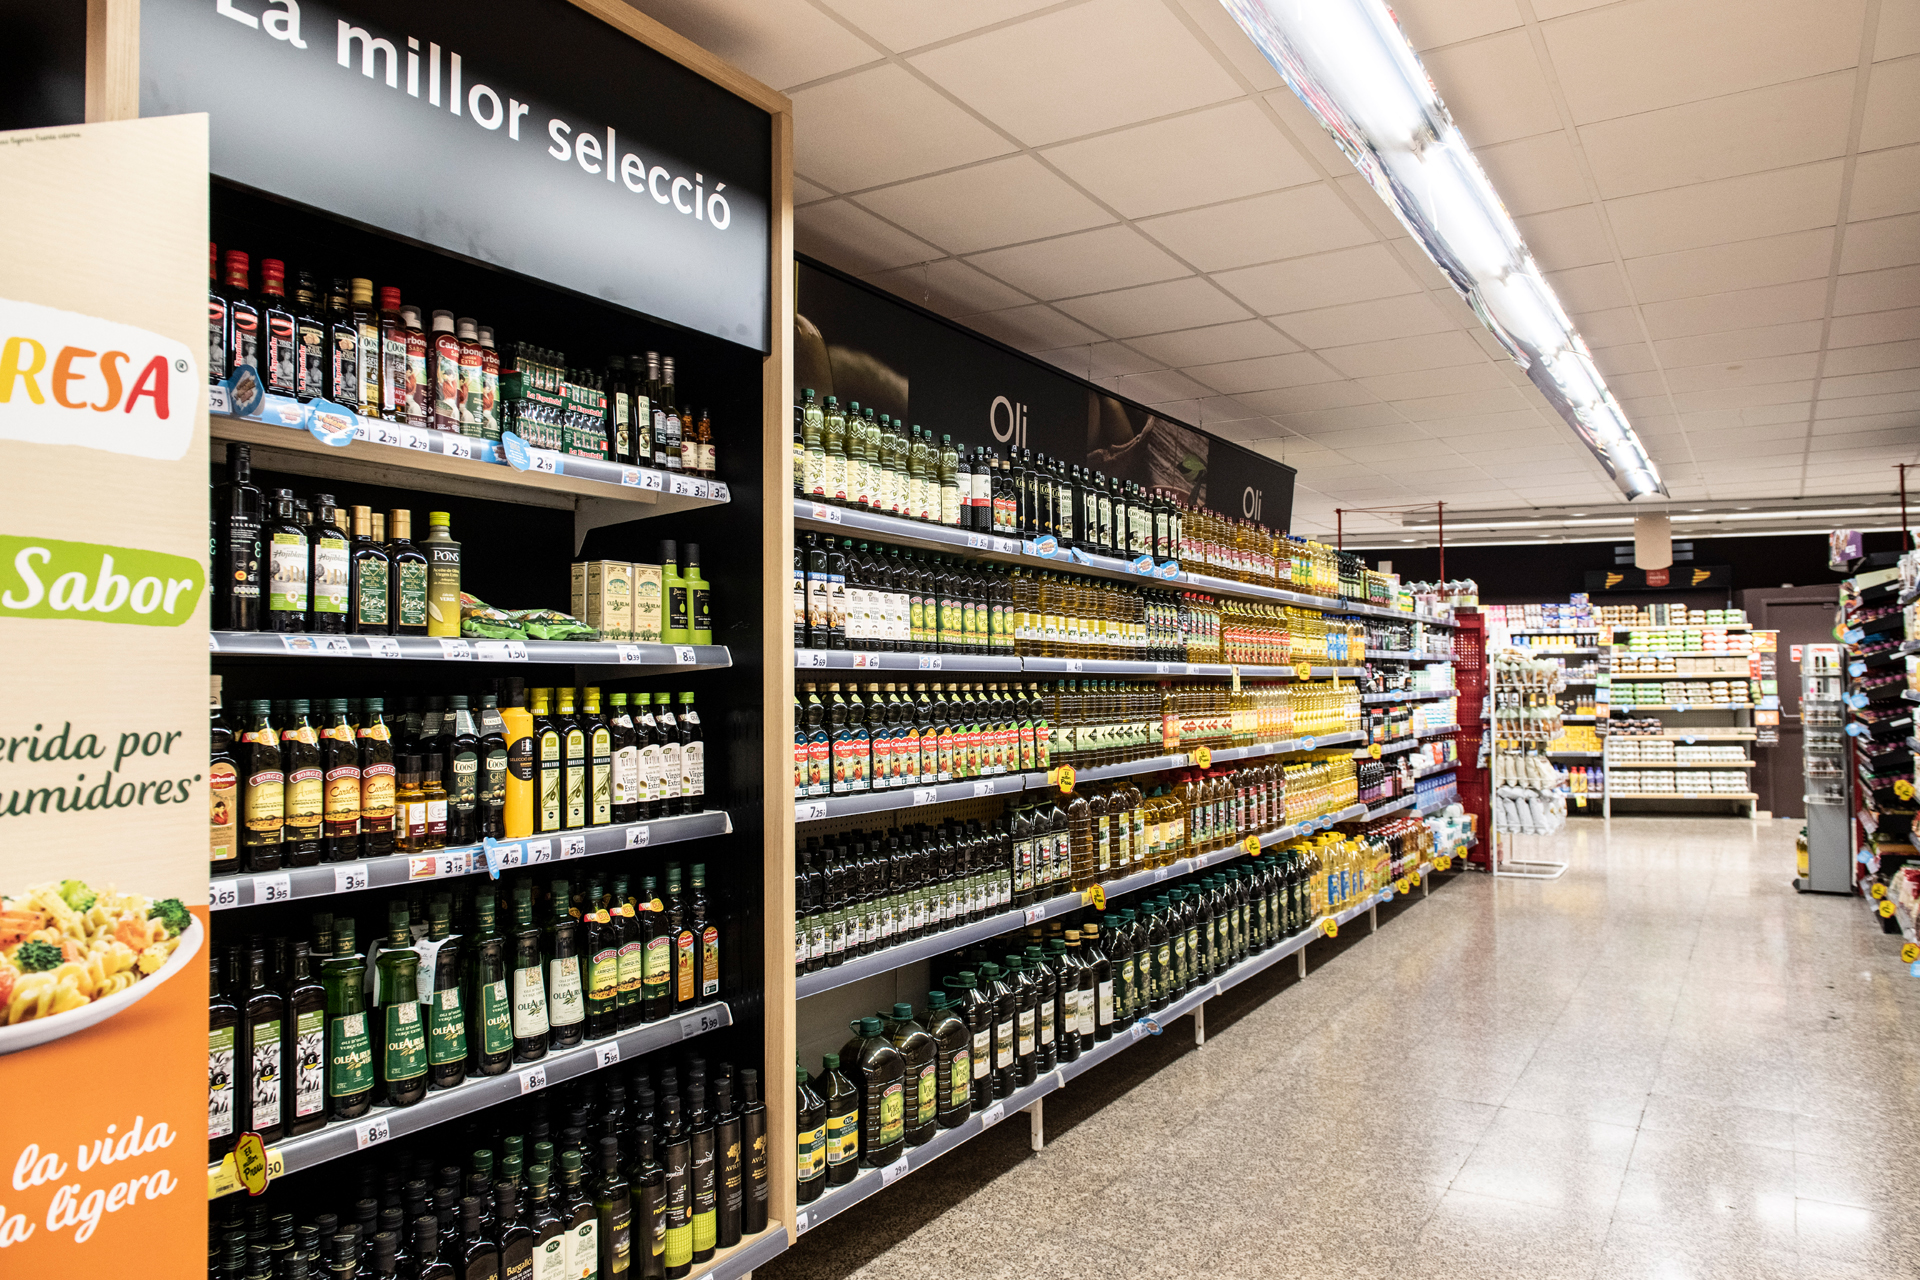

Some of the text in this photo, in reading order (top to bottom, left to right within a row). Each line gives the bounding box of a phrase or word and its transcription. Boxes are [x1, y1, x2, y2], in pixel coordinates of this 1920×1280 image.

[338, 19, 529, 142] millor
[548, 126, 732, 231] selecció
[0, 337, 169, 420] RESA
[535, 392, 562, 406] Española
[577, 405, 603, 417] Española
[990, 395, 1028, 449] Oli
[578, 449, 604, 461] Española
[1243, 486, 1262, 521] Oli
[433, 549, 460, 562] PONS
[2, 546, 193, 615] Sabor
[113, 730, 182, 773] por
[331, 768, 358, 777] BORGES
[368, 767, 394, 775] BORGES
[569, 843, 584, 855] 5,05
[502, 853, 519, 865] 4,49
[445, 860, 463, 874] 3,15
[345, 876, 365, 889] 3,95
[265, 886, 288, 900] 3,95
[651, 901, 662, 910] DUO
[678, 935, 693, 944] Carbonell
[703, 930, 718, 939] Carbonell
[368, 1127, 388, 1142] 8,99
[12, 1115, 176, 1191] la vida
[243, 1164, 263, 1181] Preu
[46, 1168, 178, 1244] ligera
[580, 1226, 591, 1235] DUC
[547, 1241, 559, 1252] DUC
[506, 1256, 533, 1277] Bargalló
